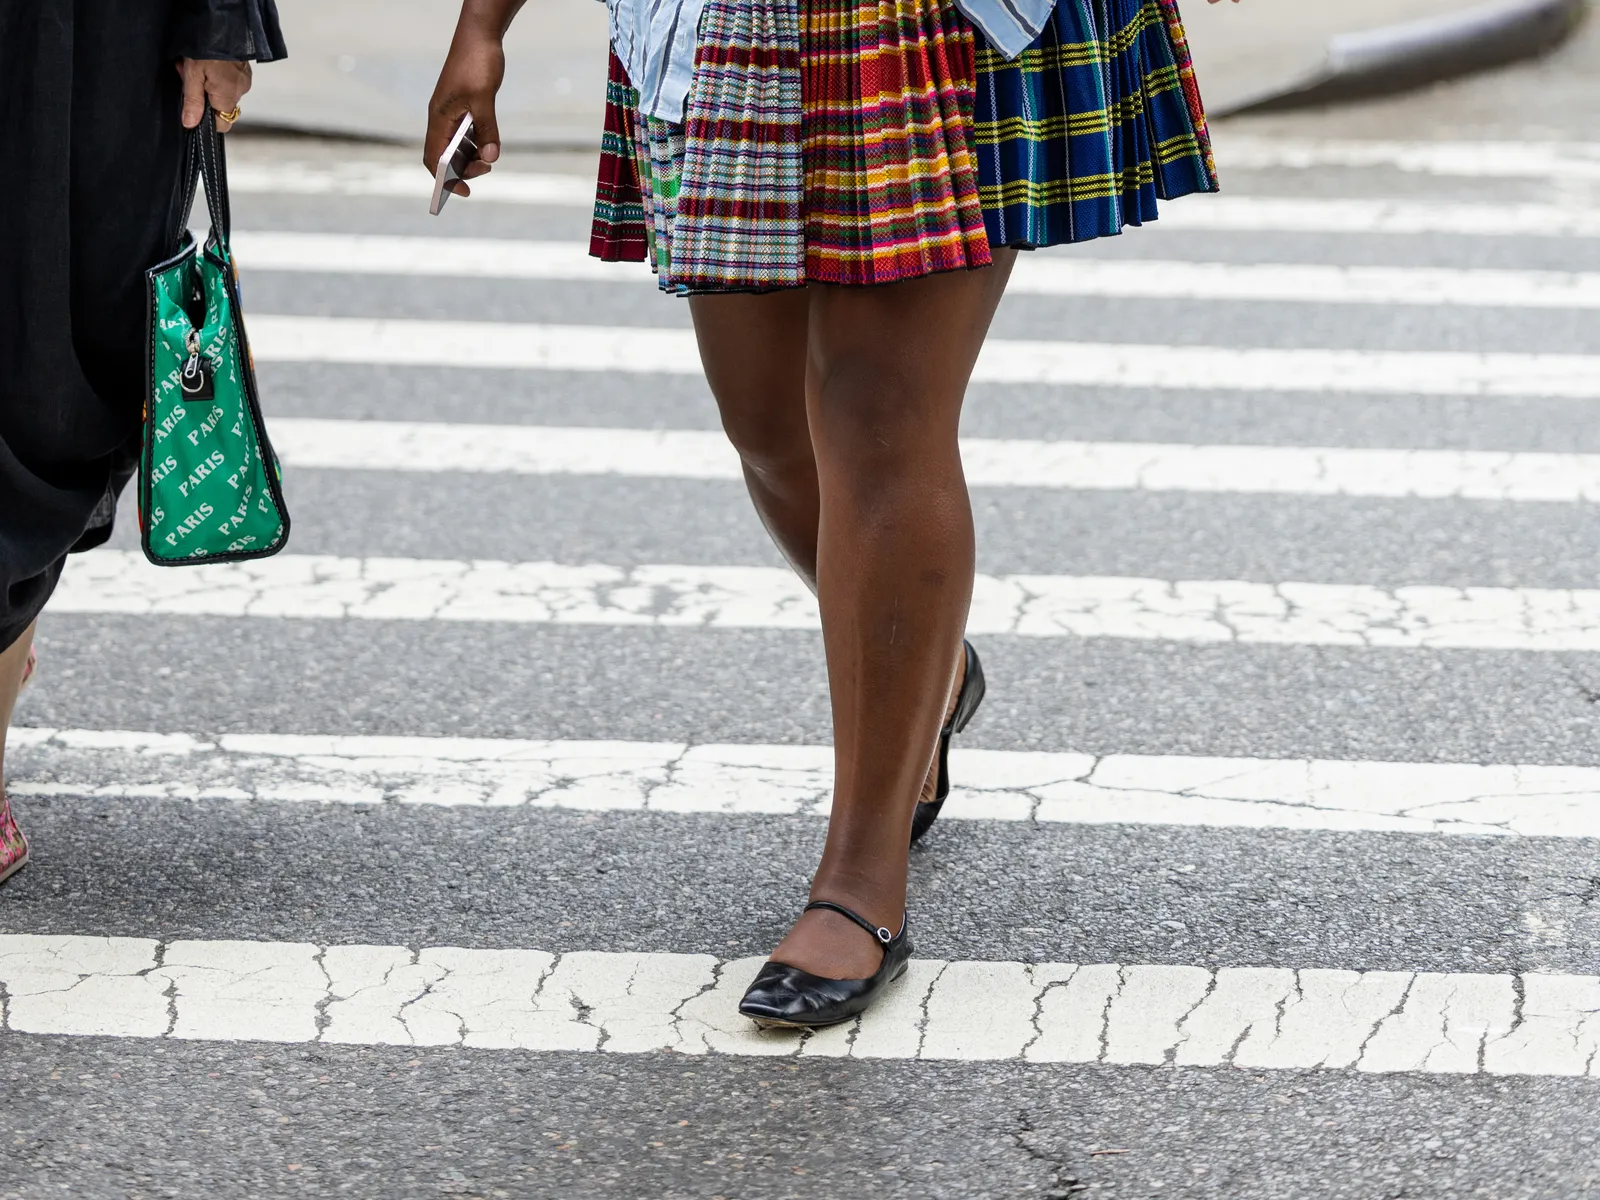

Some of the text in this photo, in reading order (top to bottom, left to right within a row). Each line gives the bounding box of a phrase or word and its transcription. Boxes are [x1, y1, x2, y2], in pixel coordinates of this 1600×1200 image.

[187, 405, 224, 447] PARIS
[151, 455, 178, 488] RIS
[178, 450, 225, 498] PARIS
[165, 502, 214, 547] PARIS
[218, 485, 252, 536] PARIS
